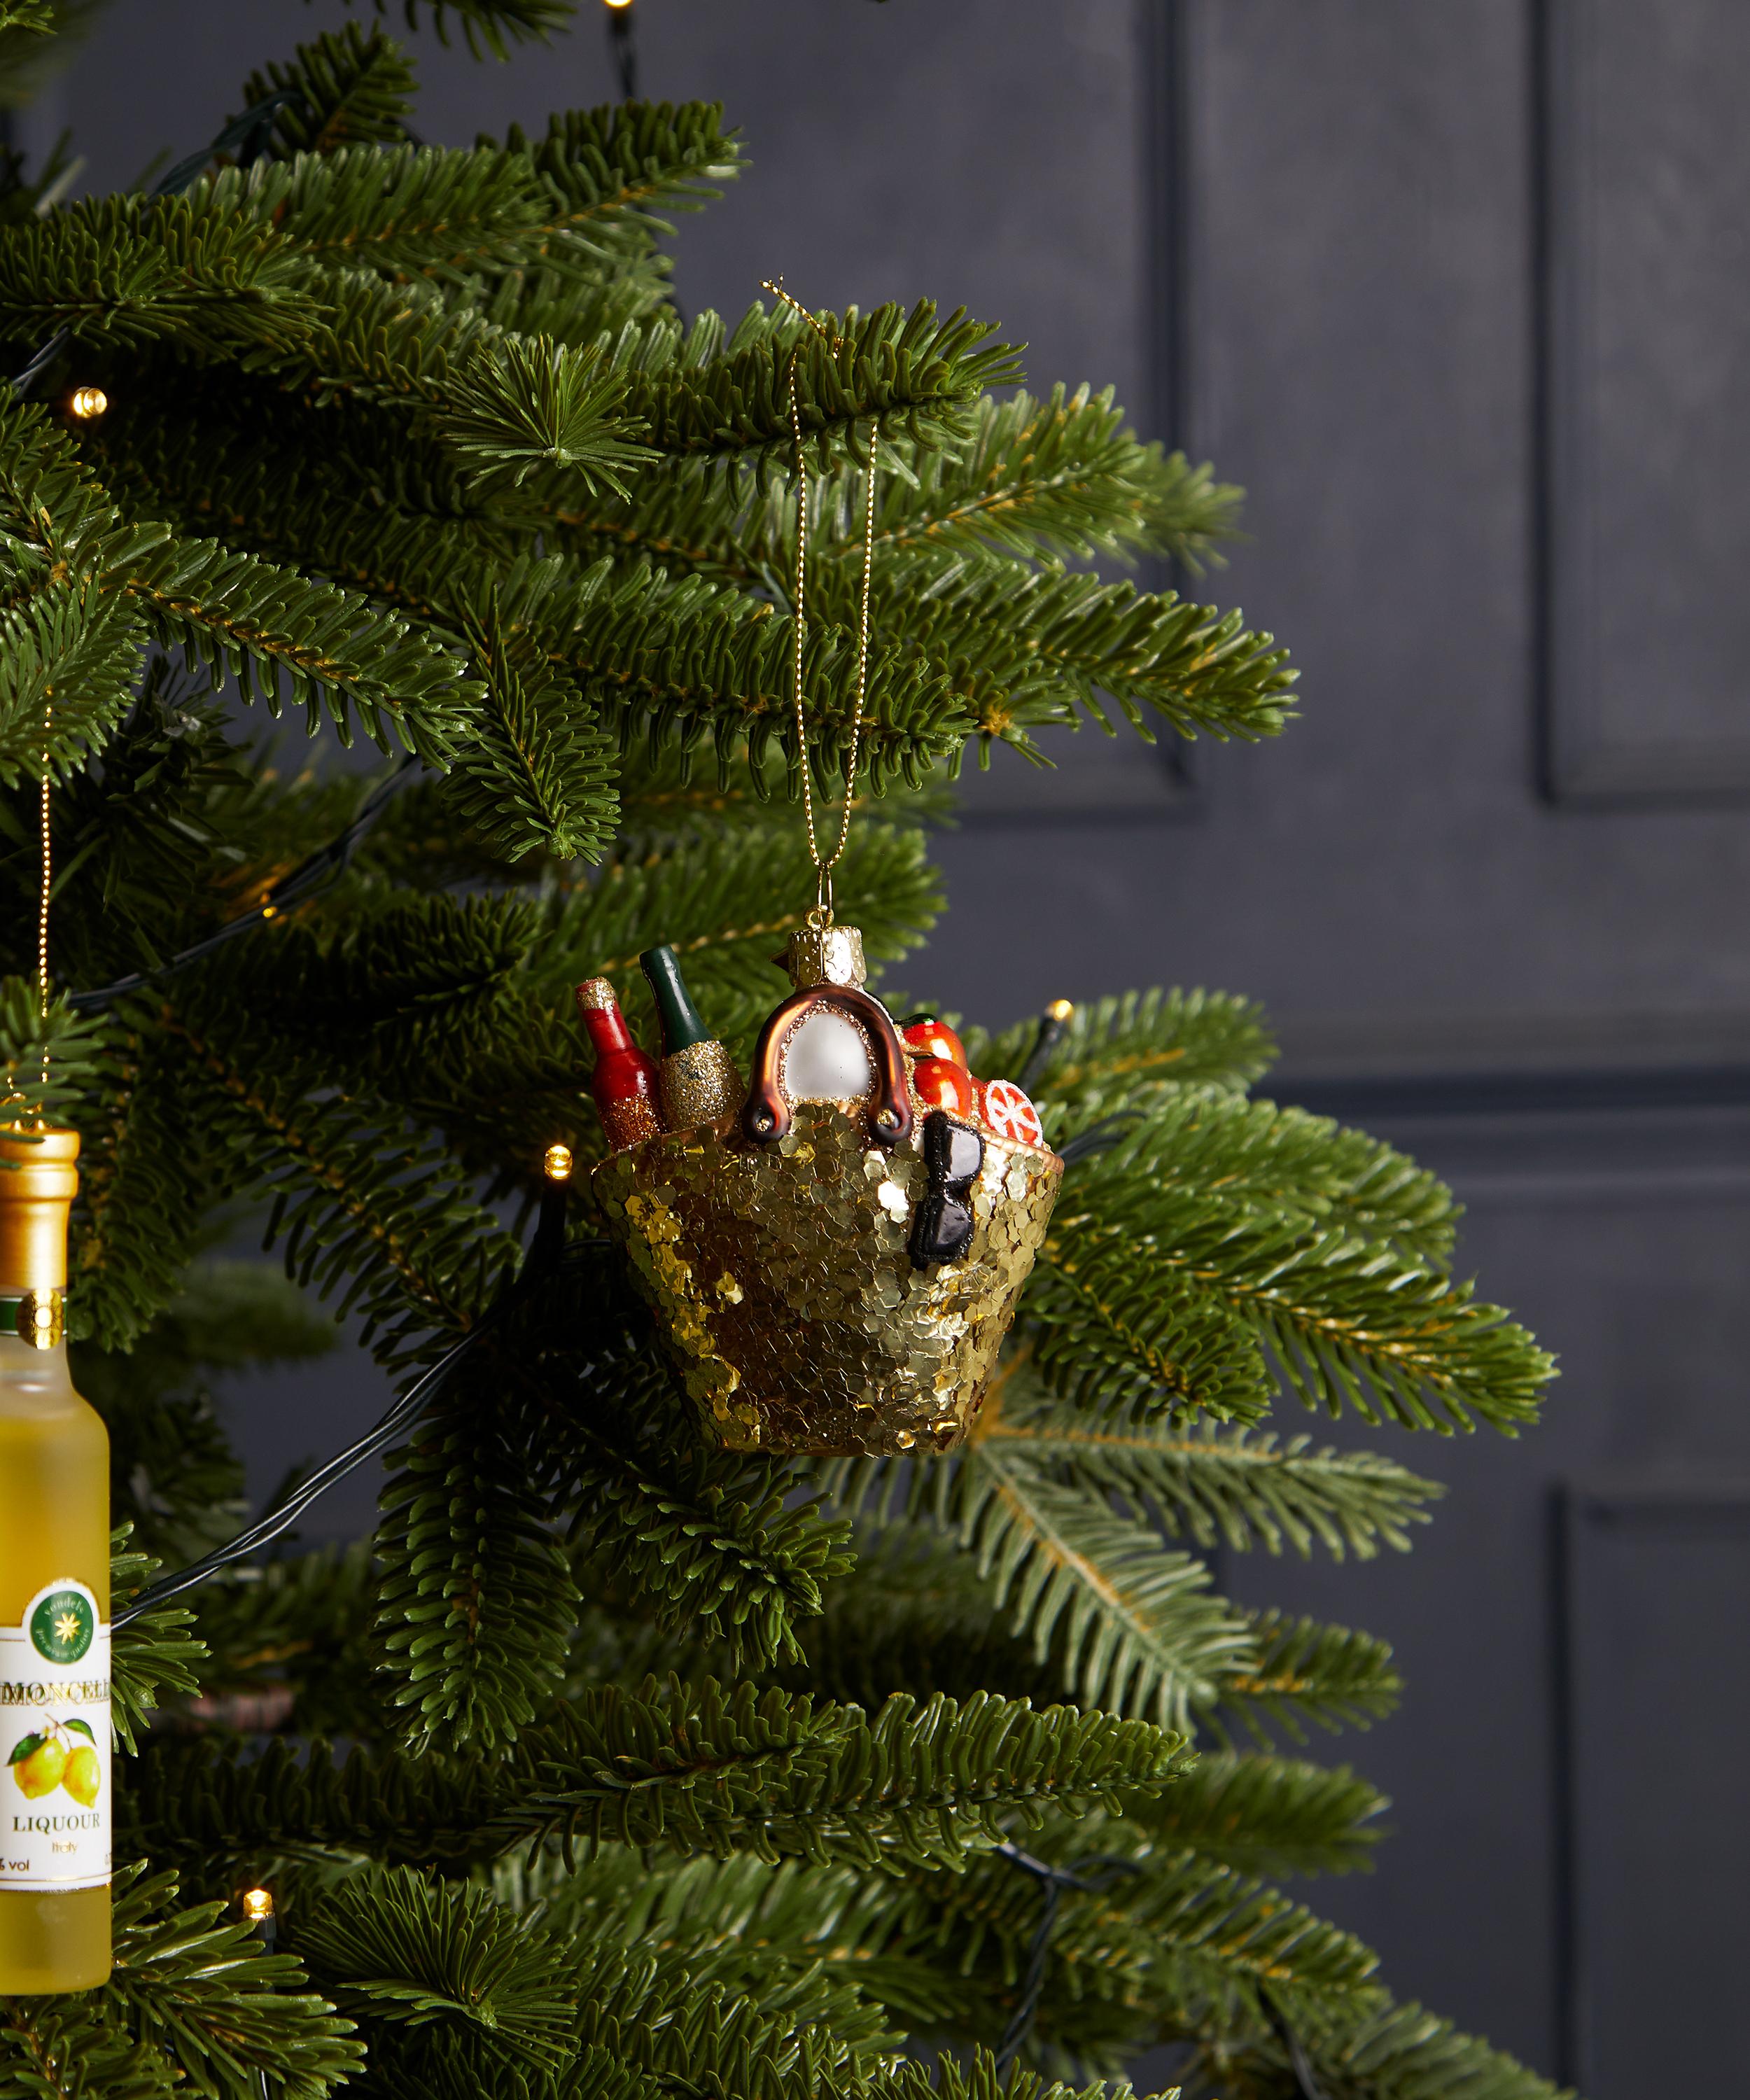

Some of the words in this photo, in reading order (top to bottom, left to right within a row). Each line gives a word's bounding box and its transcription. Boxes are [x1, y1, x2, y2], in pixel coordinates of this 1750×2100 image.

[13, 1813, 100, 1835] LIQUOUR
[52, 1842, 77, 1854] Italy
[8, 1859, 30, 1871] vol
